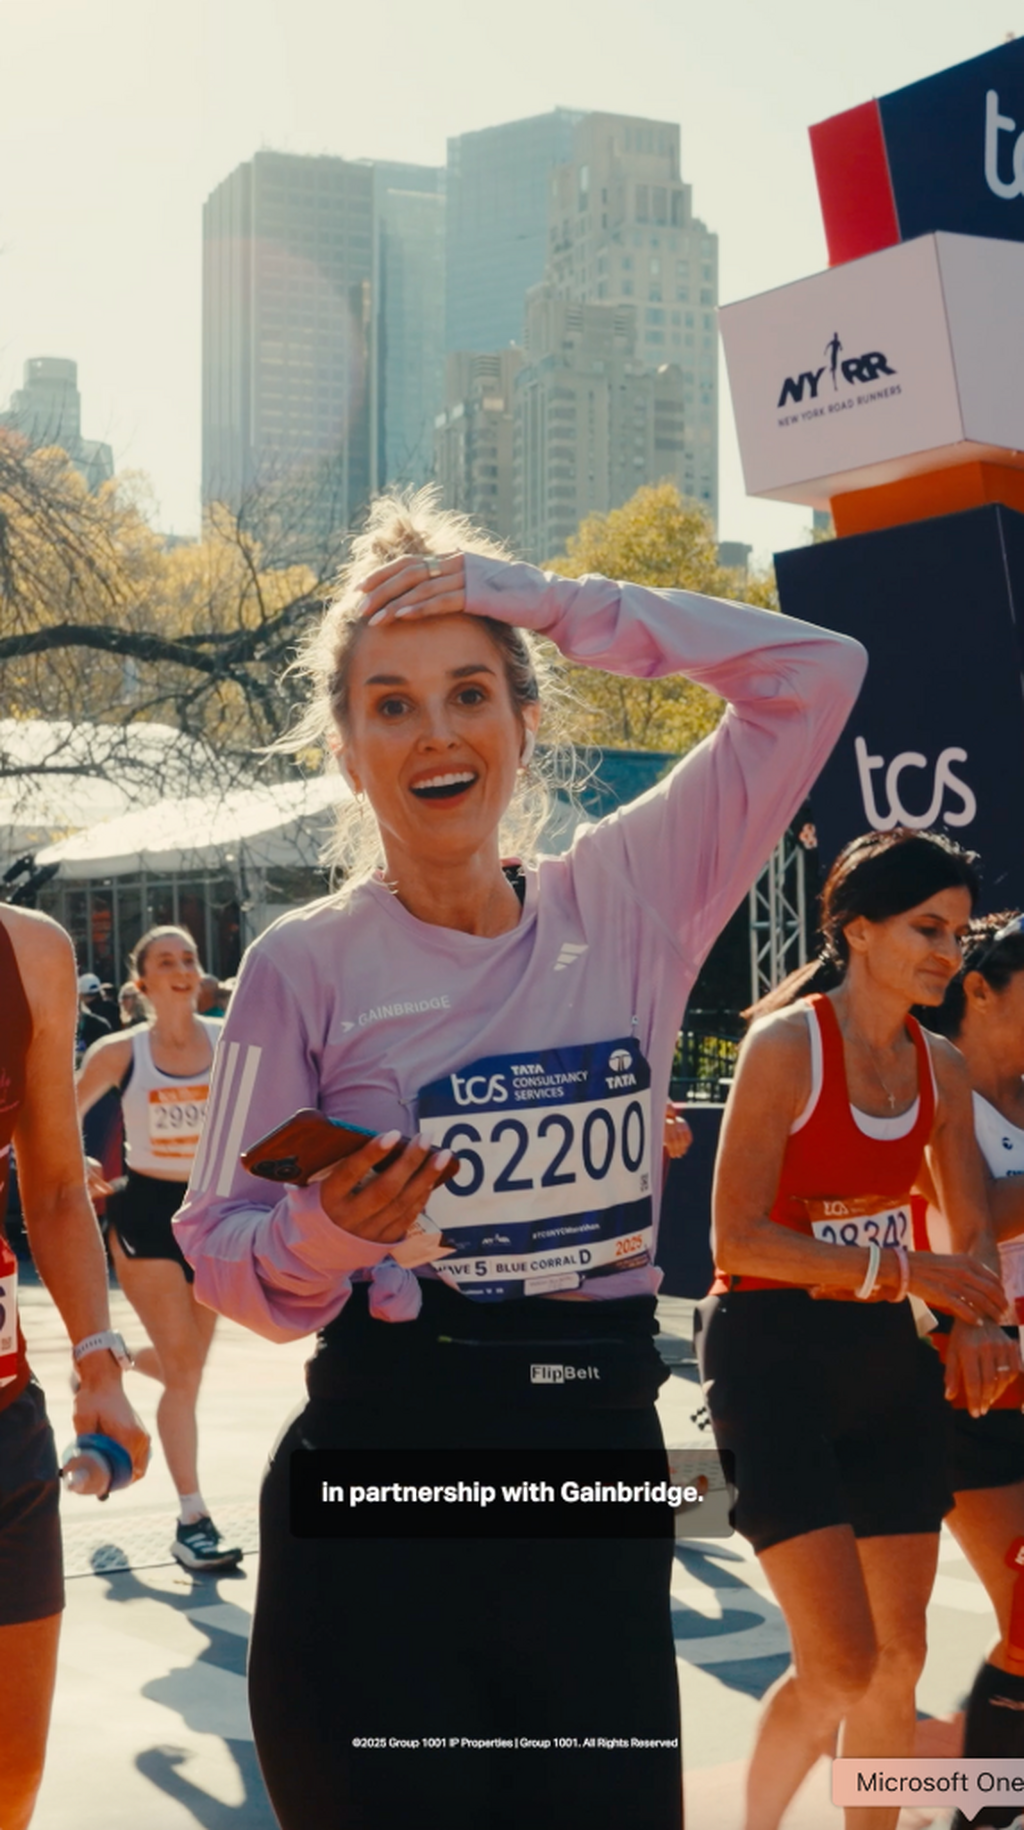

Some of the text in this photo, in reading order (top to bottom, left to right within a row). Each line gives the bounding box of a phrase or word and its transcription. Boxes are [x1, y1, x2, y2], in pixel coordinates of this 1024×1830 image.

[984, 89, 1024, 199] t
[777, 384, 901, 429] NEW YORK ROAD RUNNERS
[854, 735, 977, 831] tcs
[358, 994, 452, 1026] GAINBRIDGE
[510, 1063, 545, 1075] TATA
[512, 1070, 588, 1088] CONSULTANCY
[605, 1074, 637, 1090] TATA
[450, 1072, 509, 1106] tcs
[514, 1087, 564, 1102] SERVICES
[442, 1100, 646, 1197] 62200
[615, 1234, 643, 1256] 2025
[475, 1260, 488, 1277] 5
[496, 1262, 527, 1273] BLUE
[530, 1256, 578, 1271] CORRAL
[578, 1248, 592, 1265] D
[531, 1365, 601, 1382] FlipBelt
